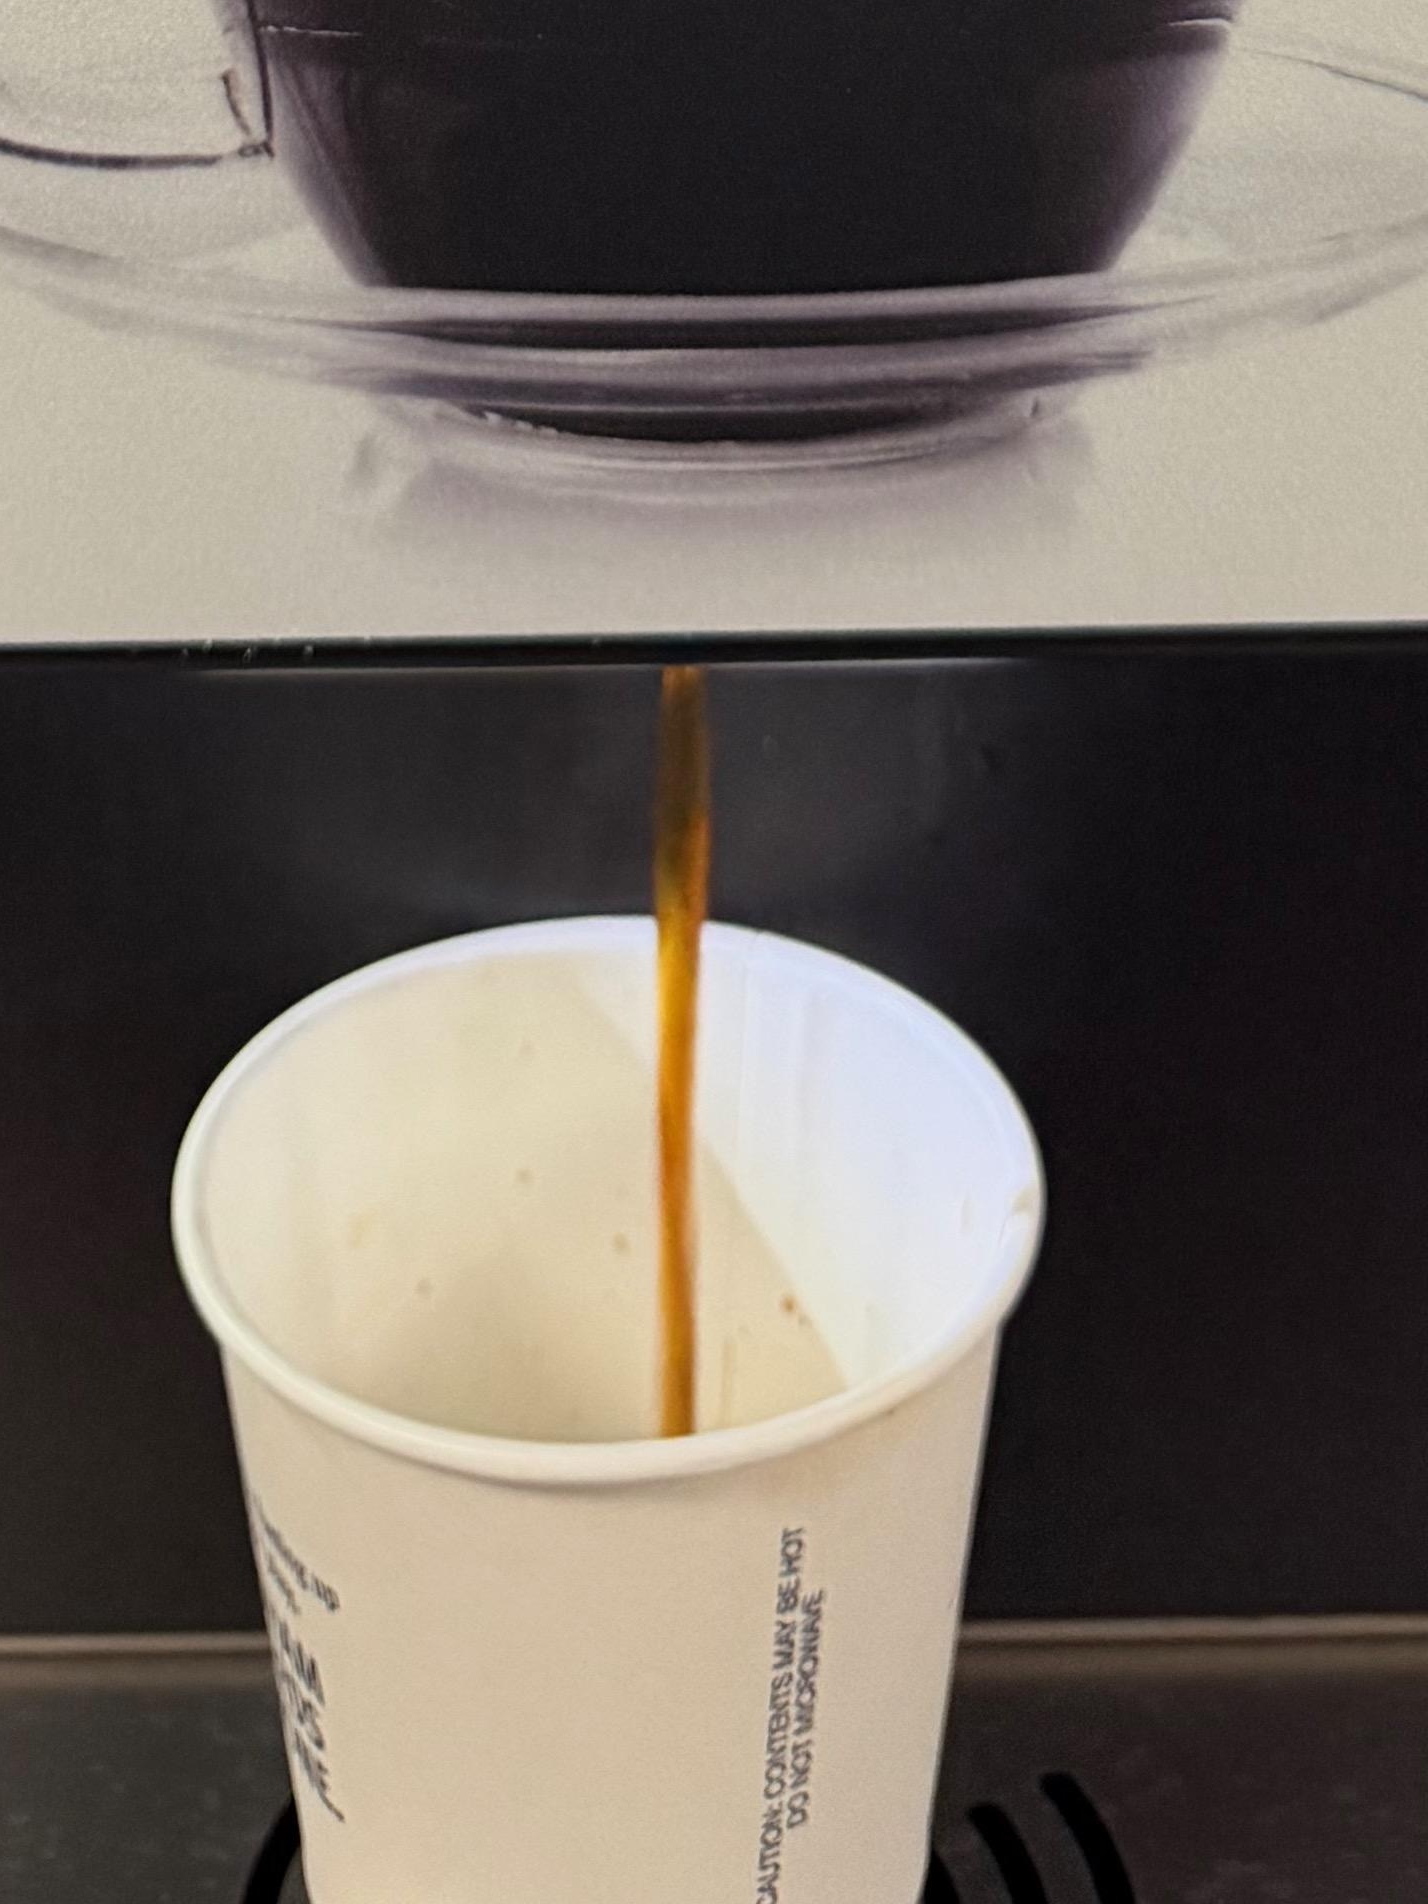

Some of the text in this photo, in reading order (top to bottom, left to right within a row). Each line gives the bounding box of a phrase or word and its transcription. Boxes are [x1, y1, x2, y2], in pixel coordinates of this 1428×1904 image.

[778, 1527, 805, 1577] HOT
[776, 1578, 800, 1615] BE
[773, 1620, 798, 1670] MAY
[786, 1590, 825, 1829] DO NOT MICROWAVE
[763, 1672, 793, 1798] CONTENTS
